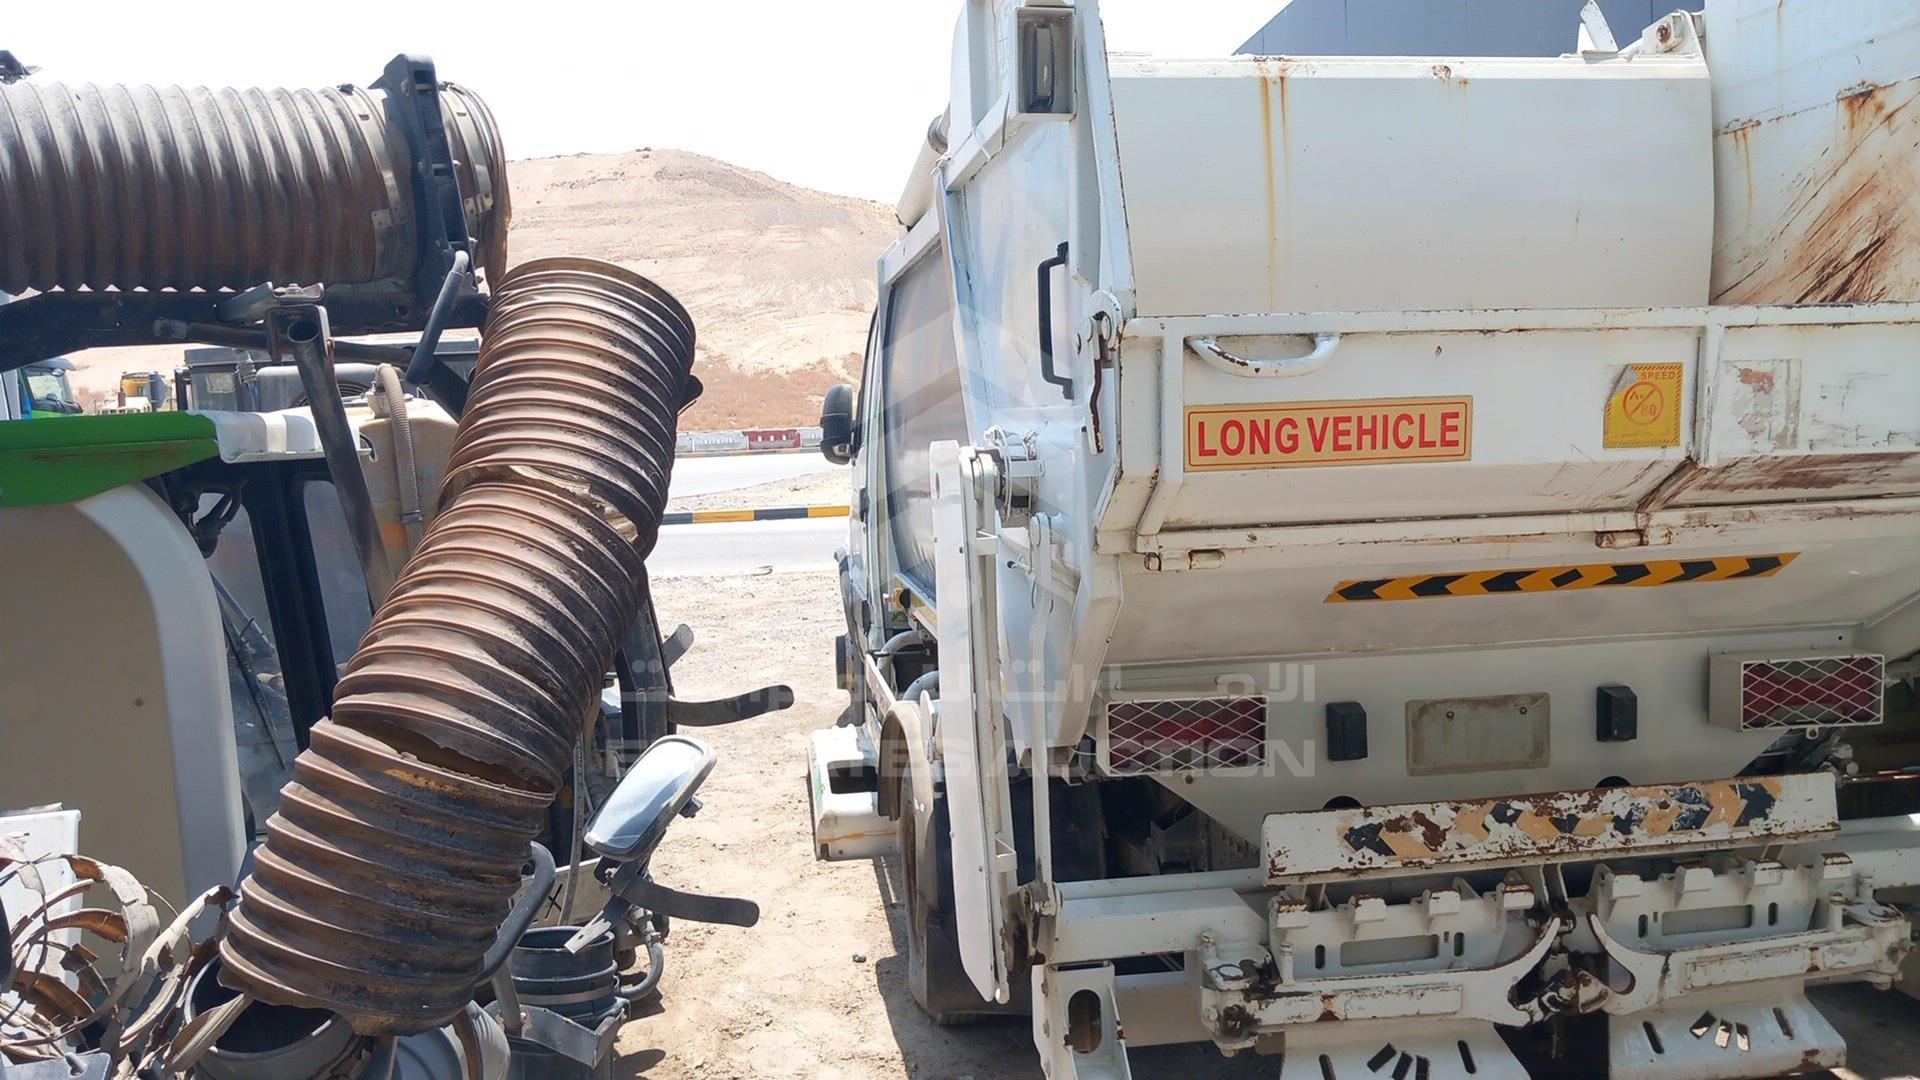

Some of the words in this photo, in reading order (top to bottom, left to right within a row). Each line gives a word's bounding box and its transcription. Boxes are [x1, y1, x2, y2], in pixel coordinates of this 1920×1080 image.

[1641, 371, 1675, 380] SPEED
[1198, 417, 1299, 457] LONG
[1307, 412, 1460, 452] VEHICLE
